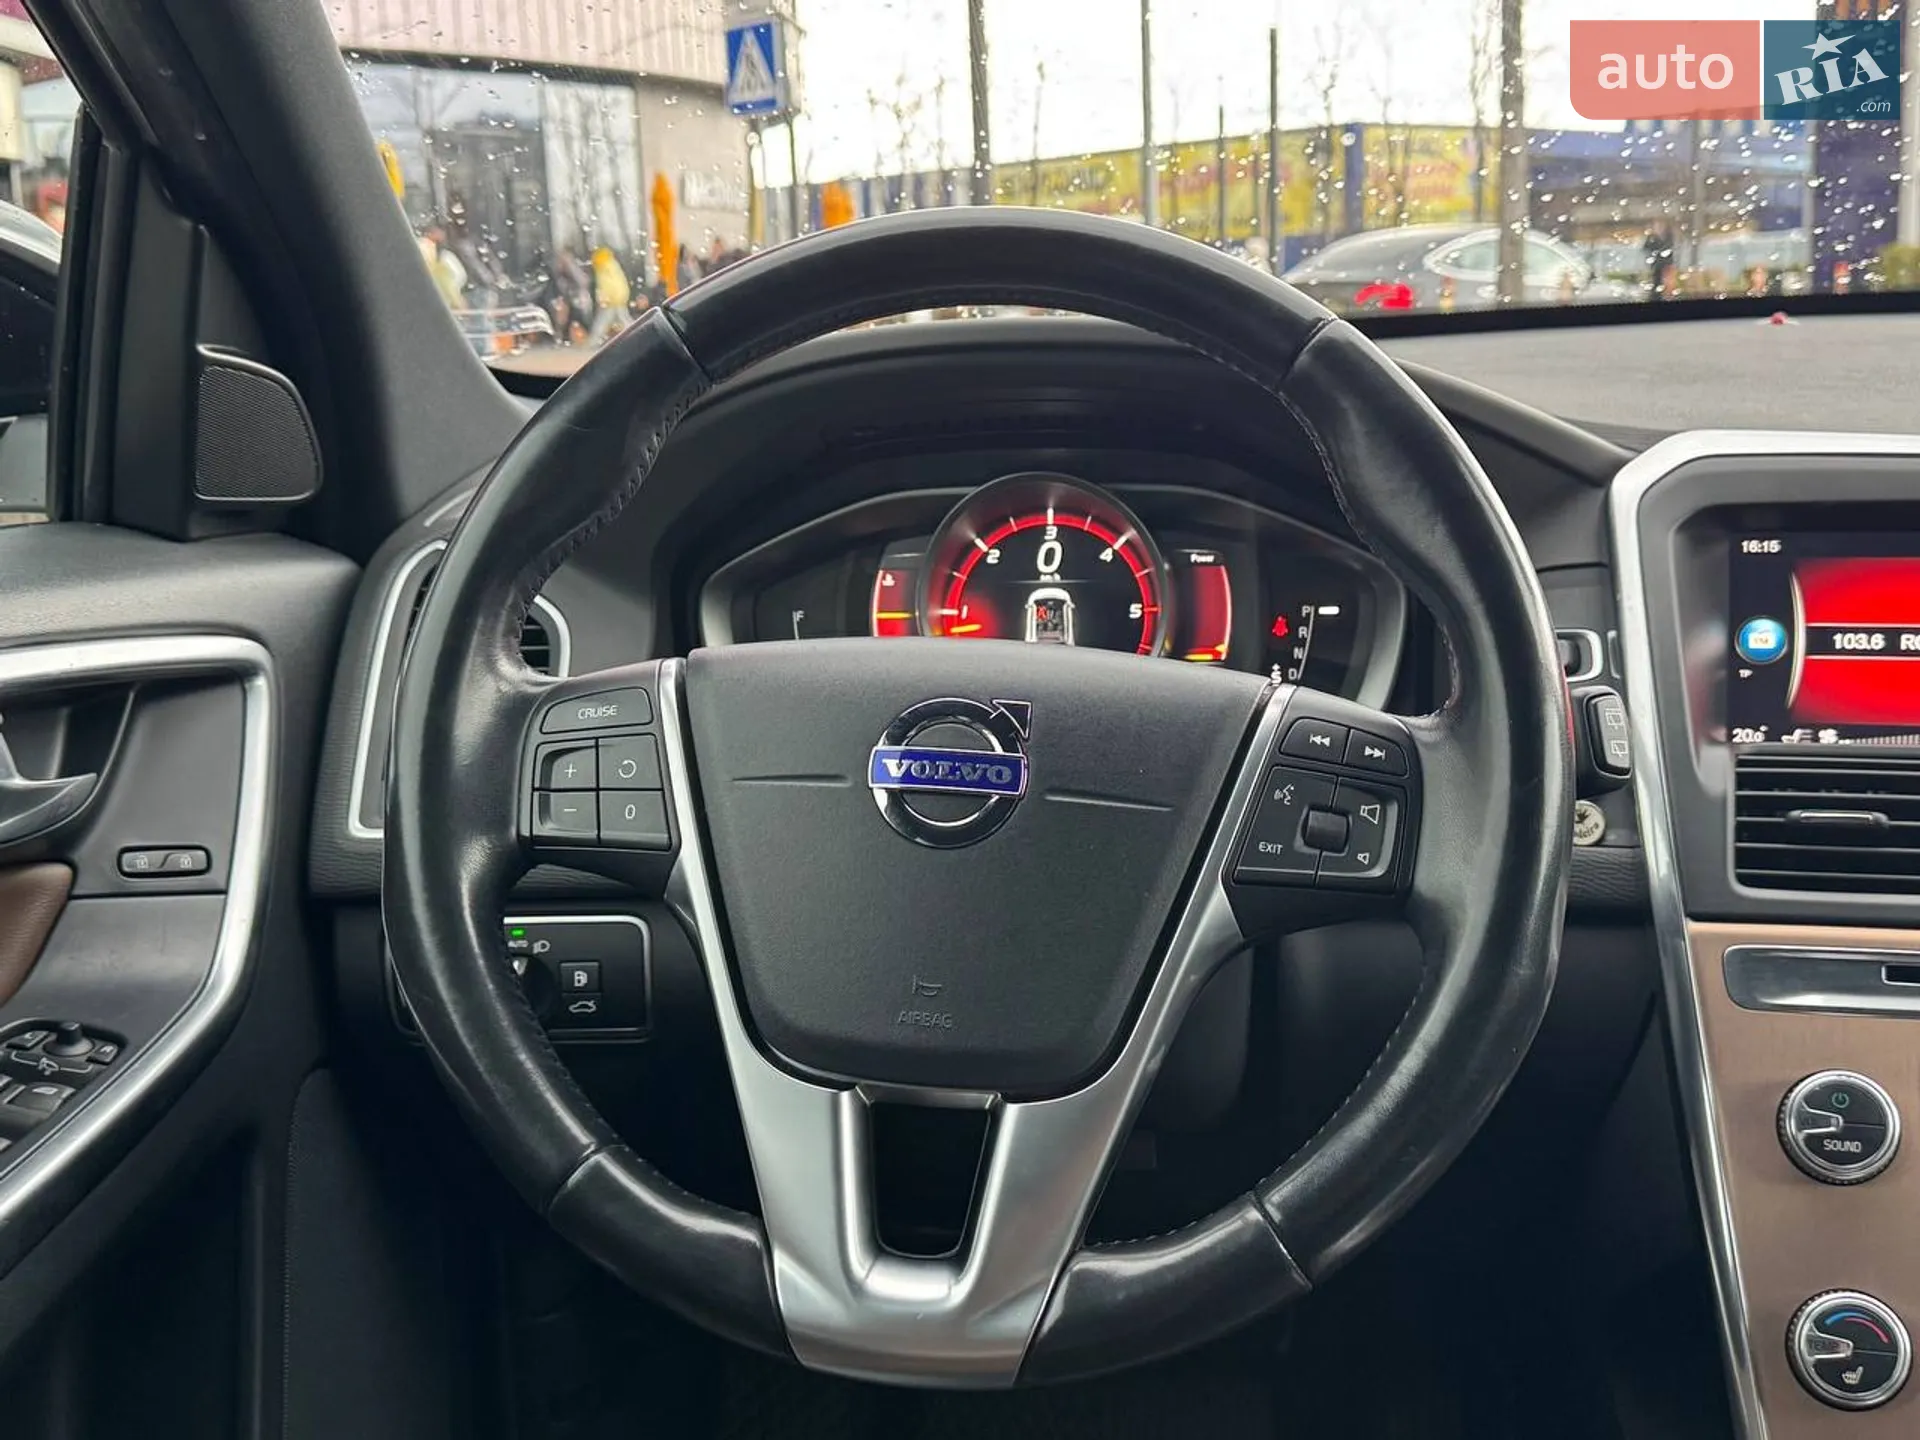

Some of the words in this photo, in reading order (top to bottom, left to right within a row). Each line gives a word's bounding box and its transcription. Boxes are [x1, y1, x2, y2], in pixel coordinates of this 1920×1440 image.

[1044, 526, 1057, 540] 3
[1741, 539, 1782, 554] 16:15
[986, 548, 1000, 564] 2
[1037, 540, 1062, 574] 0
[1099, 547, 1113, 562] 4
[1129, 603, 1142, 619] 5
[1302, 605, 1311, 618] P
[1298, 626, 1307, 639] R
[1833, 632, 1886, 650] 103.6
[1293, 646, 1303, 660] N
[577, 704, 620, 720] CRUISE
[882, 758, 1012, 785] VOLVO
[1258, 841, 1284, 855] EXIT
[898, 1010, 953, 1029] AIRBAG
[1823, 1138, 1862, 1153] SOUND
